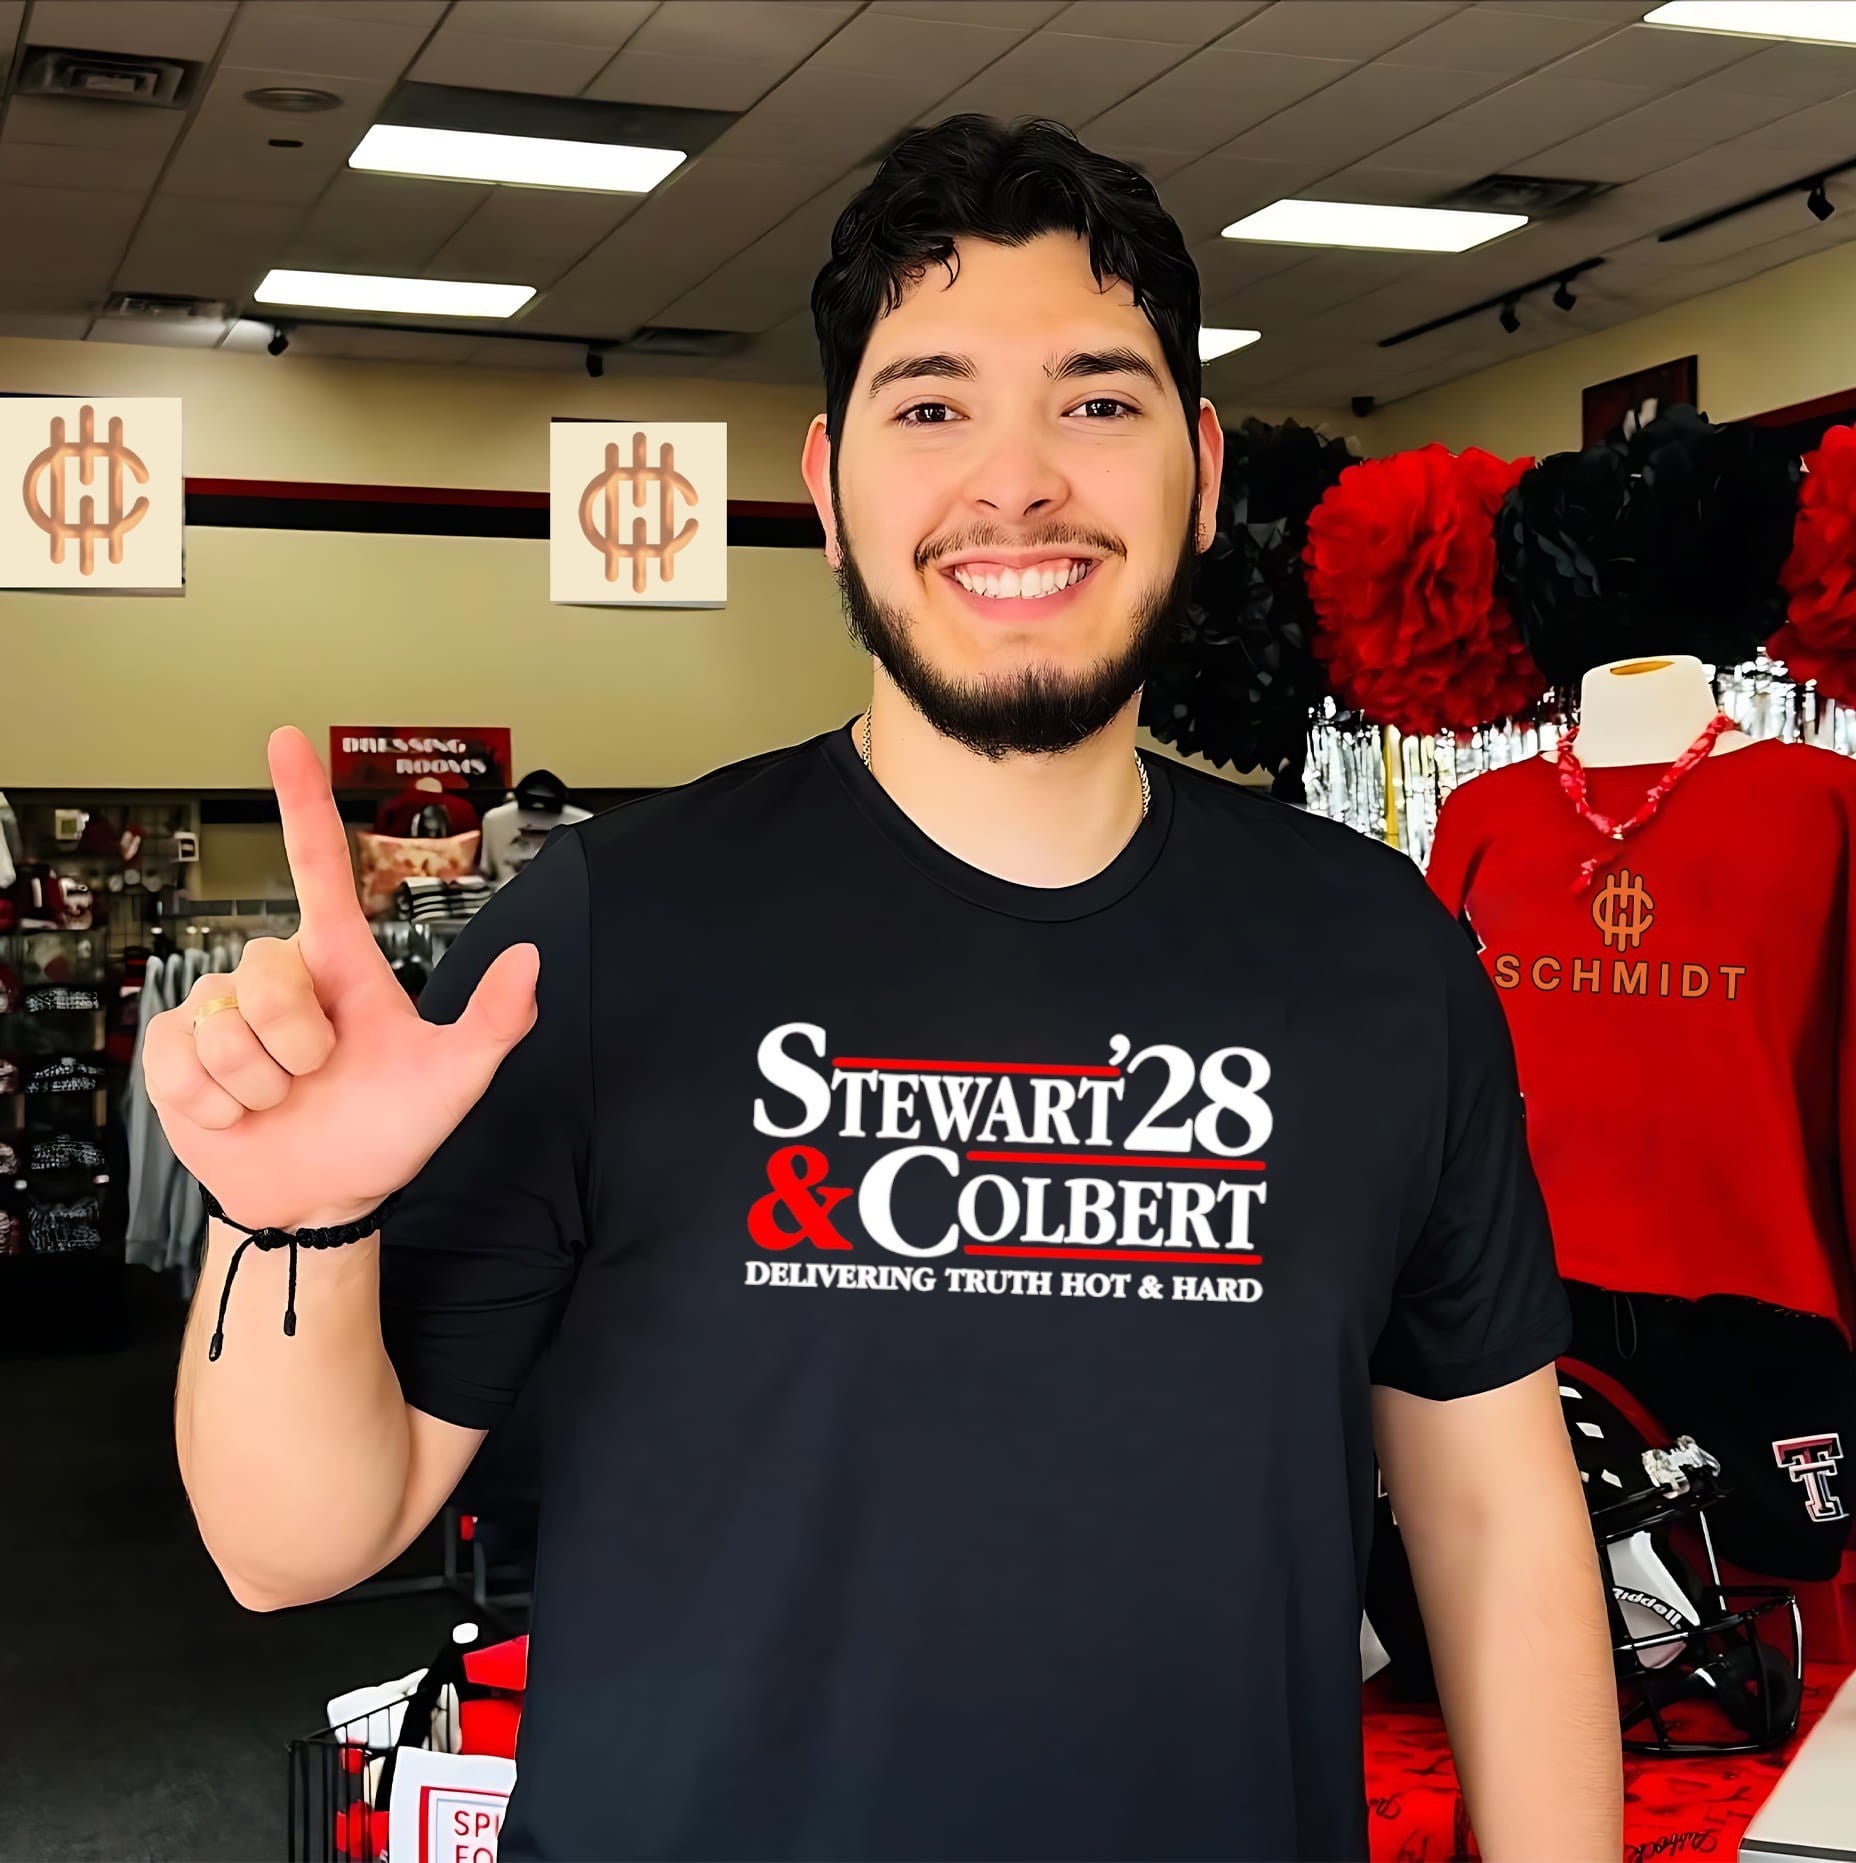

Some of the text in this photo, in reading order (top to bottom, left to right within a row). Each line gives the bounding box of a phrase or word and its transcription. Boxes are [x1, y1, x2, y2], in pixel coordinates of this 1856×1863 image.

[396, 758, 487, 774] ROOMS
[1494, 954, 1746, 999] SCHMIDT
[752, 1021, 1125, 1147] STEWART
[746, 1144, 1268, 1258] & COLBERT
[744, 1260, 1264, 1303] DELIVERING TRUTH HOT & HARD
